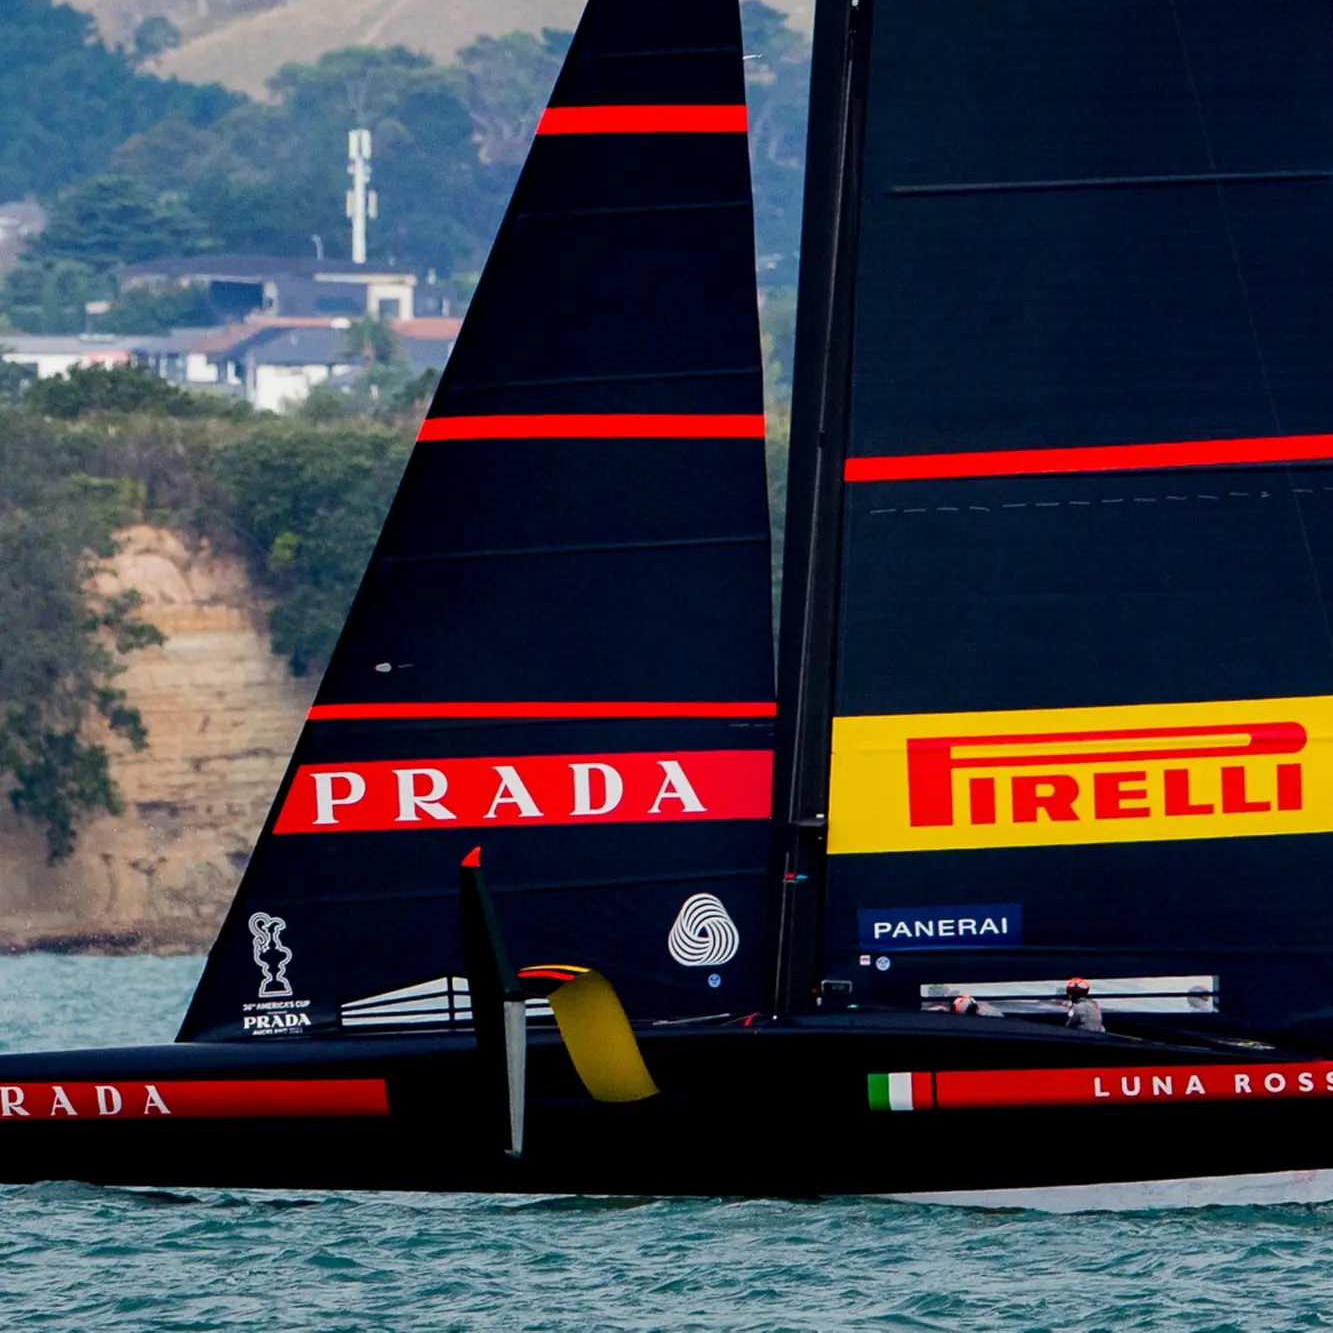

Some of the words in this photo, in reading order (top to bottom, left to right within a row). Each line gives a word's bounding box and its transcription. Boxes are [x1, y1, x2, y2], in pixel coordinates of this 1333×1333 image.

[906, 721, 1307, 827] PIRELLI
[310, 760, 707, 825] PRADA
[874, 917, 1008, 939] PANERAI
[243, 1013, 312, 1030] PRADA
[1094, 1074, 1206, 1097] LUNA
